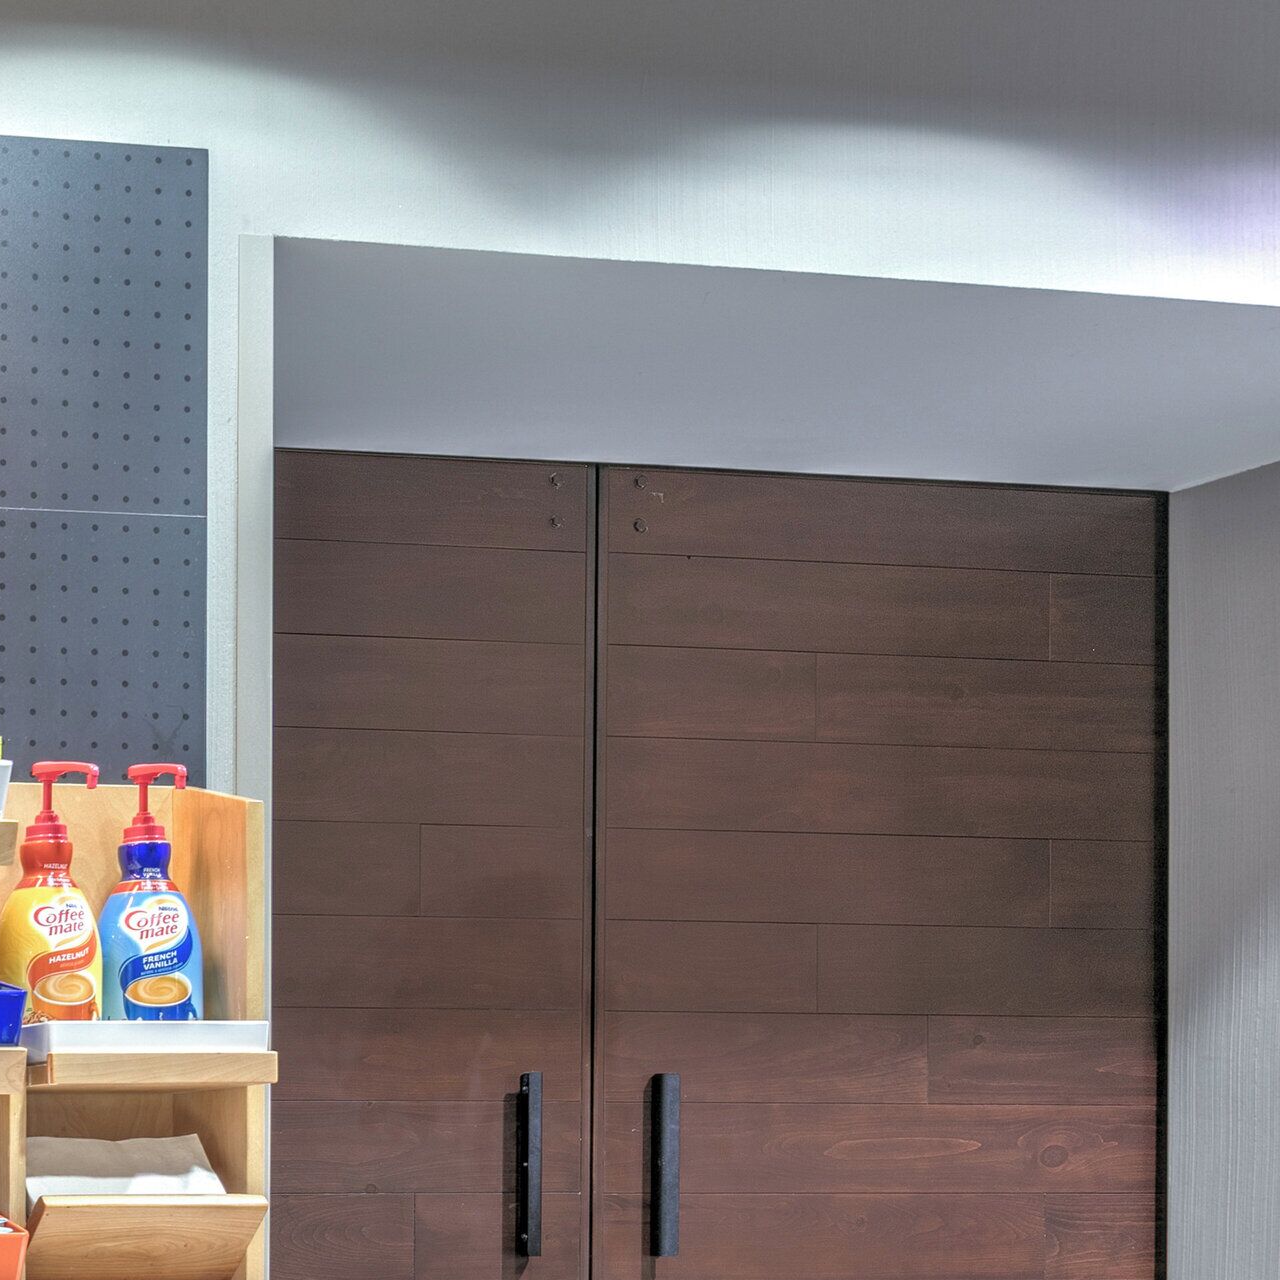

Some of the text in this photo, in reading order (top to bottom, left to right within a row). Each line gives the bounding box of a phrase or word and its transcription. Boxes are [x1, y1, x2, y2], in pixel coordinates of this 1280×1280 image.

[33, 906, 85, 927] Coffee
[125, 910, 179, 931] Coffee
[48, 920, 84, 936] mate
[139, 925, 178, 940] mate
[48, 947, 90, 965] HAZELNUT
[142, 950, 177, 964] FRENCH
[143, 958, 179, 971] VANILLA
